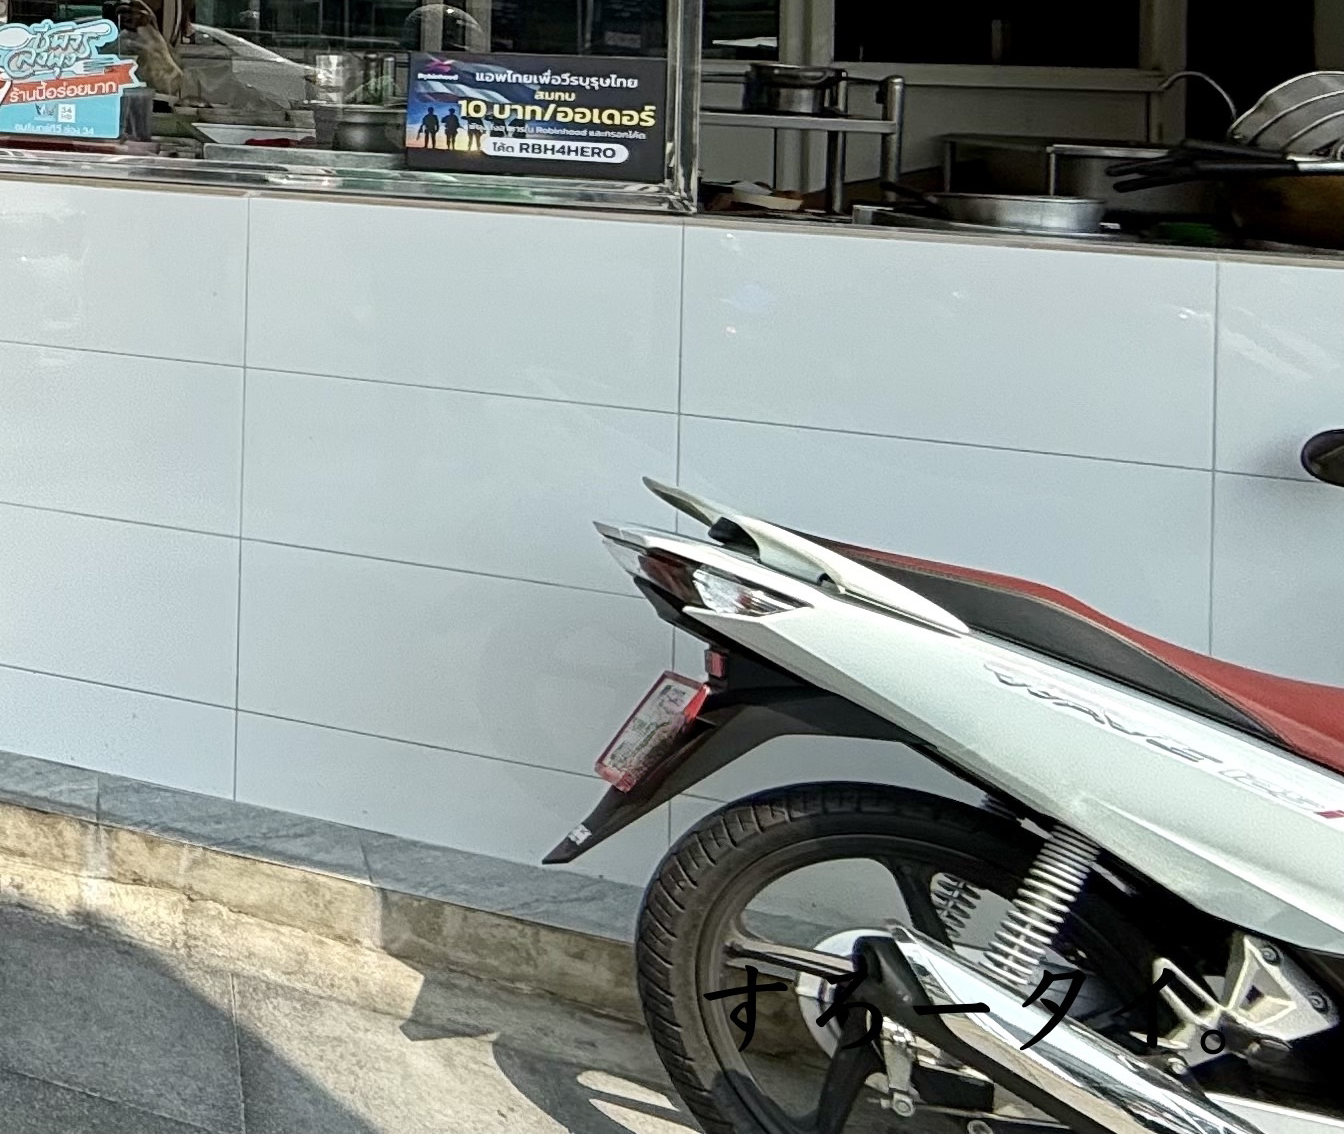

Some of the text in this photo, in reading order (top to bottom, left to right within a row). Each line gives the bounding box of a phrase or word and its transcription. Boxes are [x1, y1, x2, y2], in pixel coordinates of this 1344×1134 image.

[475, 69, 640, 91] แอพไทยเพื่อวีรบุรุษไทย
[9, 80, 117, 103] ร้านนี้อร่อยมาก
[533, 89, 576, 102] สมทบ
[457, 99, 657, 128] 10 บาท/ออเดอร์
[518, 142, 617, 159] RBH4HERO
